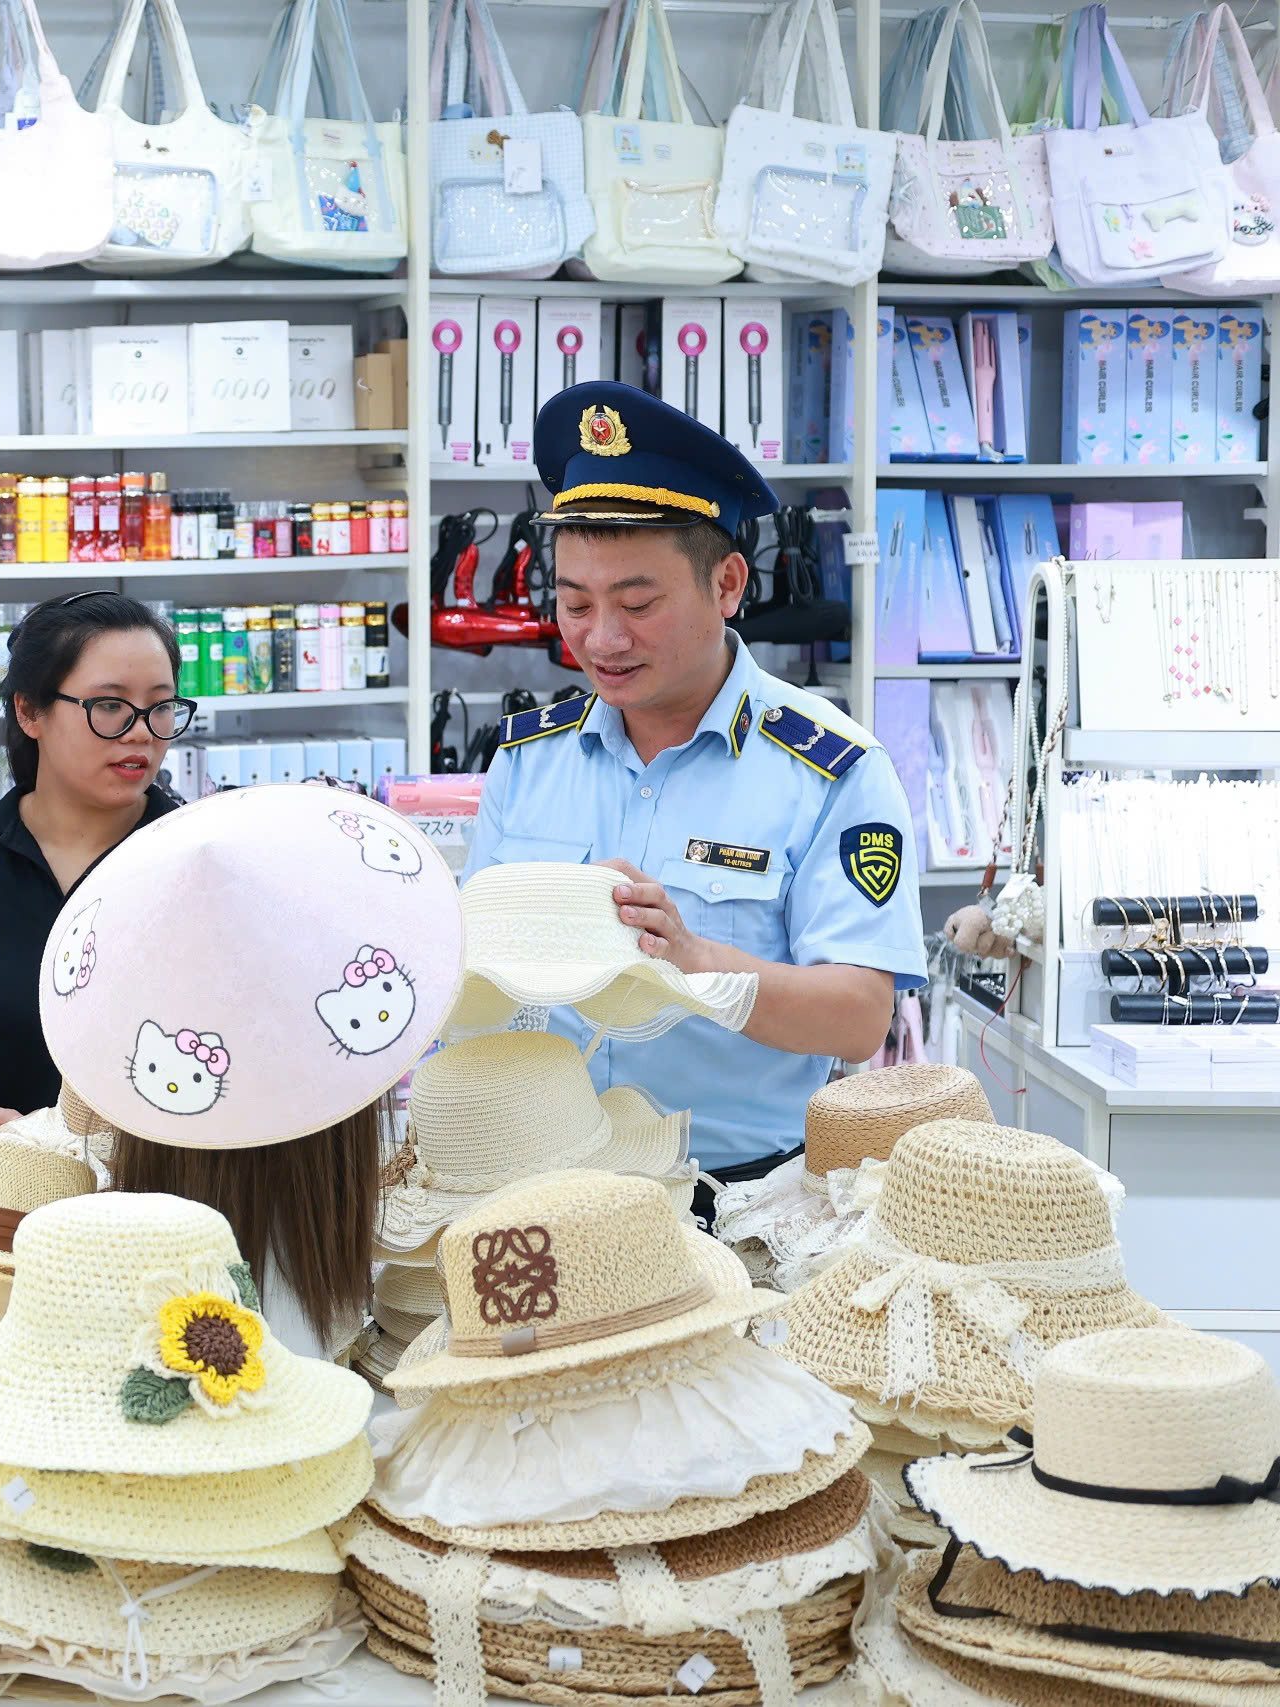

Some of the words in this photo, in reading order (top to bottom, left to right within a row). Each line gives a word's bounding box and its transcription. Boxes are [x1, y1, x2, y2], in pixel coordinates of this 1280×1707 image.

[933, 360, 944, 378] HAIR
[1098, 360, 1107, 380] HAIR
[1145, 359, 1154, 379] HAIR
[1191, 359, 1200, 379] HAIR
[1235, 360, 1243, 379] HAIR
[937, 378, 951, 408] CURLER
[1097, 380, 1107, 415] CURLER
[1144, 380, 1154, 414] CURLER
[1191, 380, 1200, 414] CURLER
[1235, 380, 1243, 413] CURLER
[418, 820, 454, 836] マスク
[859, 832, 894, 848] DMS
